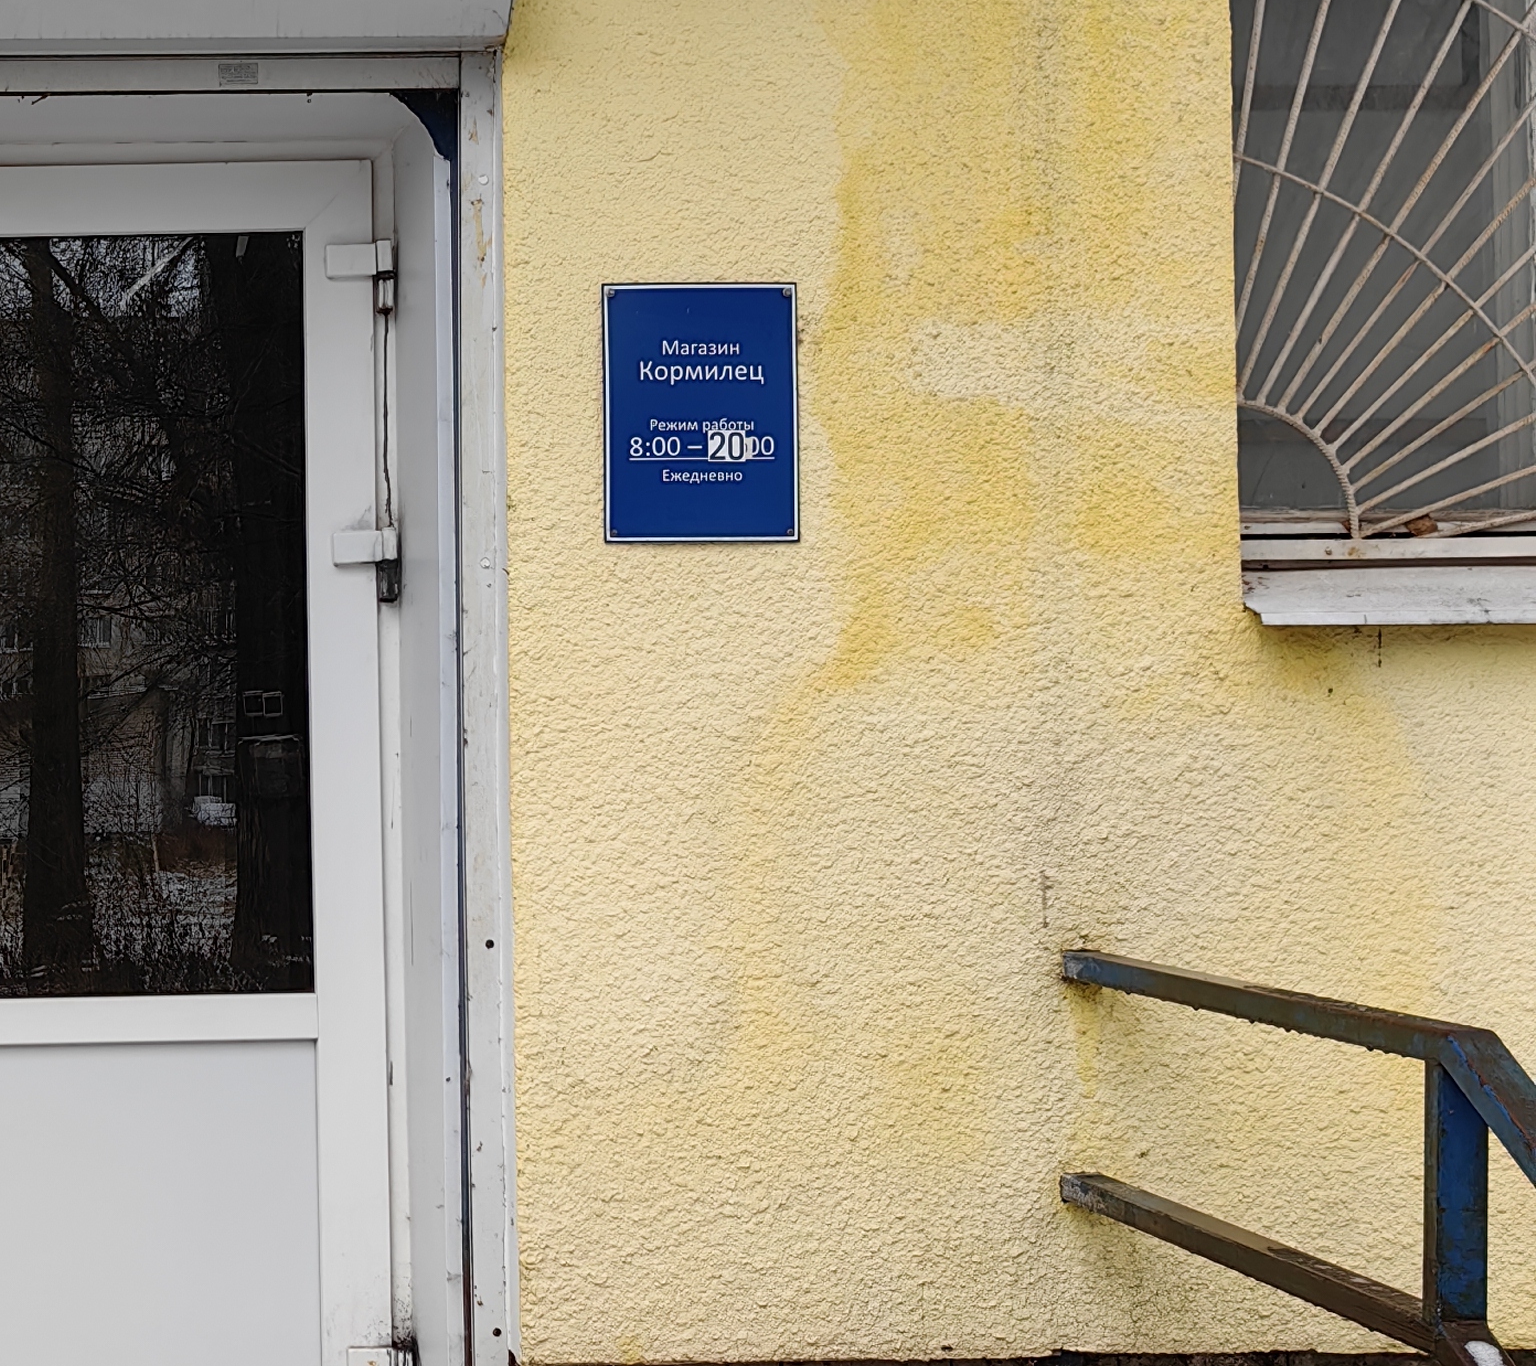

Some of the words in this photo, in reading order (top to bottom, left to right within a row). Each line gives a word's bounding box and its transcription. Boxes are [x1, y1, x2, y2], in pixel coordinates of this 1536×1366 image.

[661, 340, 741, 355] Магазин
[639, 360, 765, 385] Кормилец
[649, 419, 698, 431] Режим
[702, 417, 755, 433] работы
[629, 436, 681, 457] 8:00
[662, 469, 743, 484] Ежедневно
